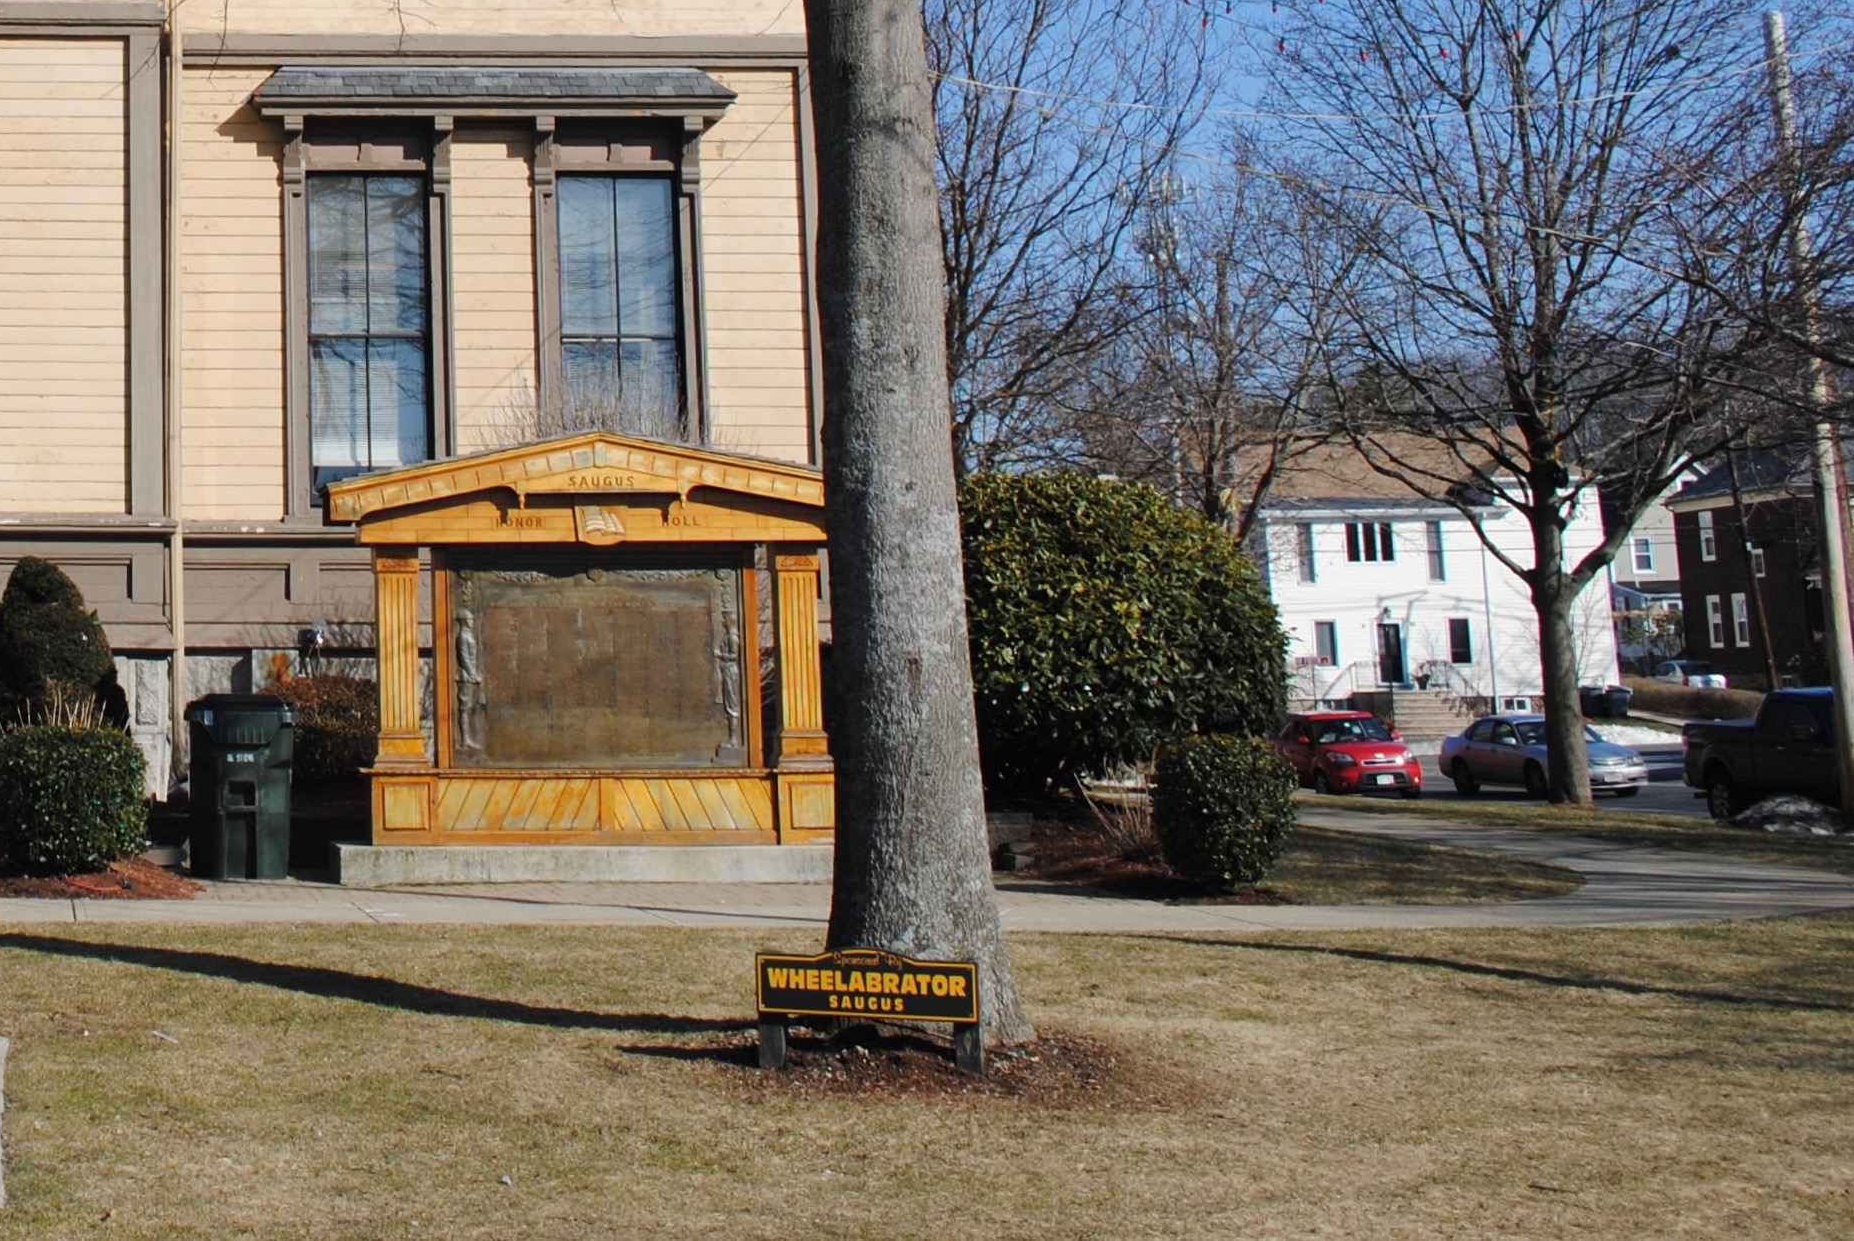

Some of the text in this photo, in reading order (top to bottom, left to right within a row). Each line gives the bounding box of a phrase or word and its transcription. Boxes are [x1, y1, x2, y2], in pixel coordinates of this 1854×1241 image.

[568, 475, 635, 488] SAUGUS
[767, 966, 968, 998] WHEELABRATOR
[829, 994, 906, 1012] SAUGUS
